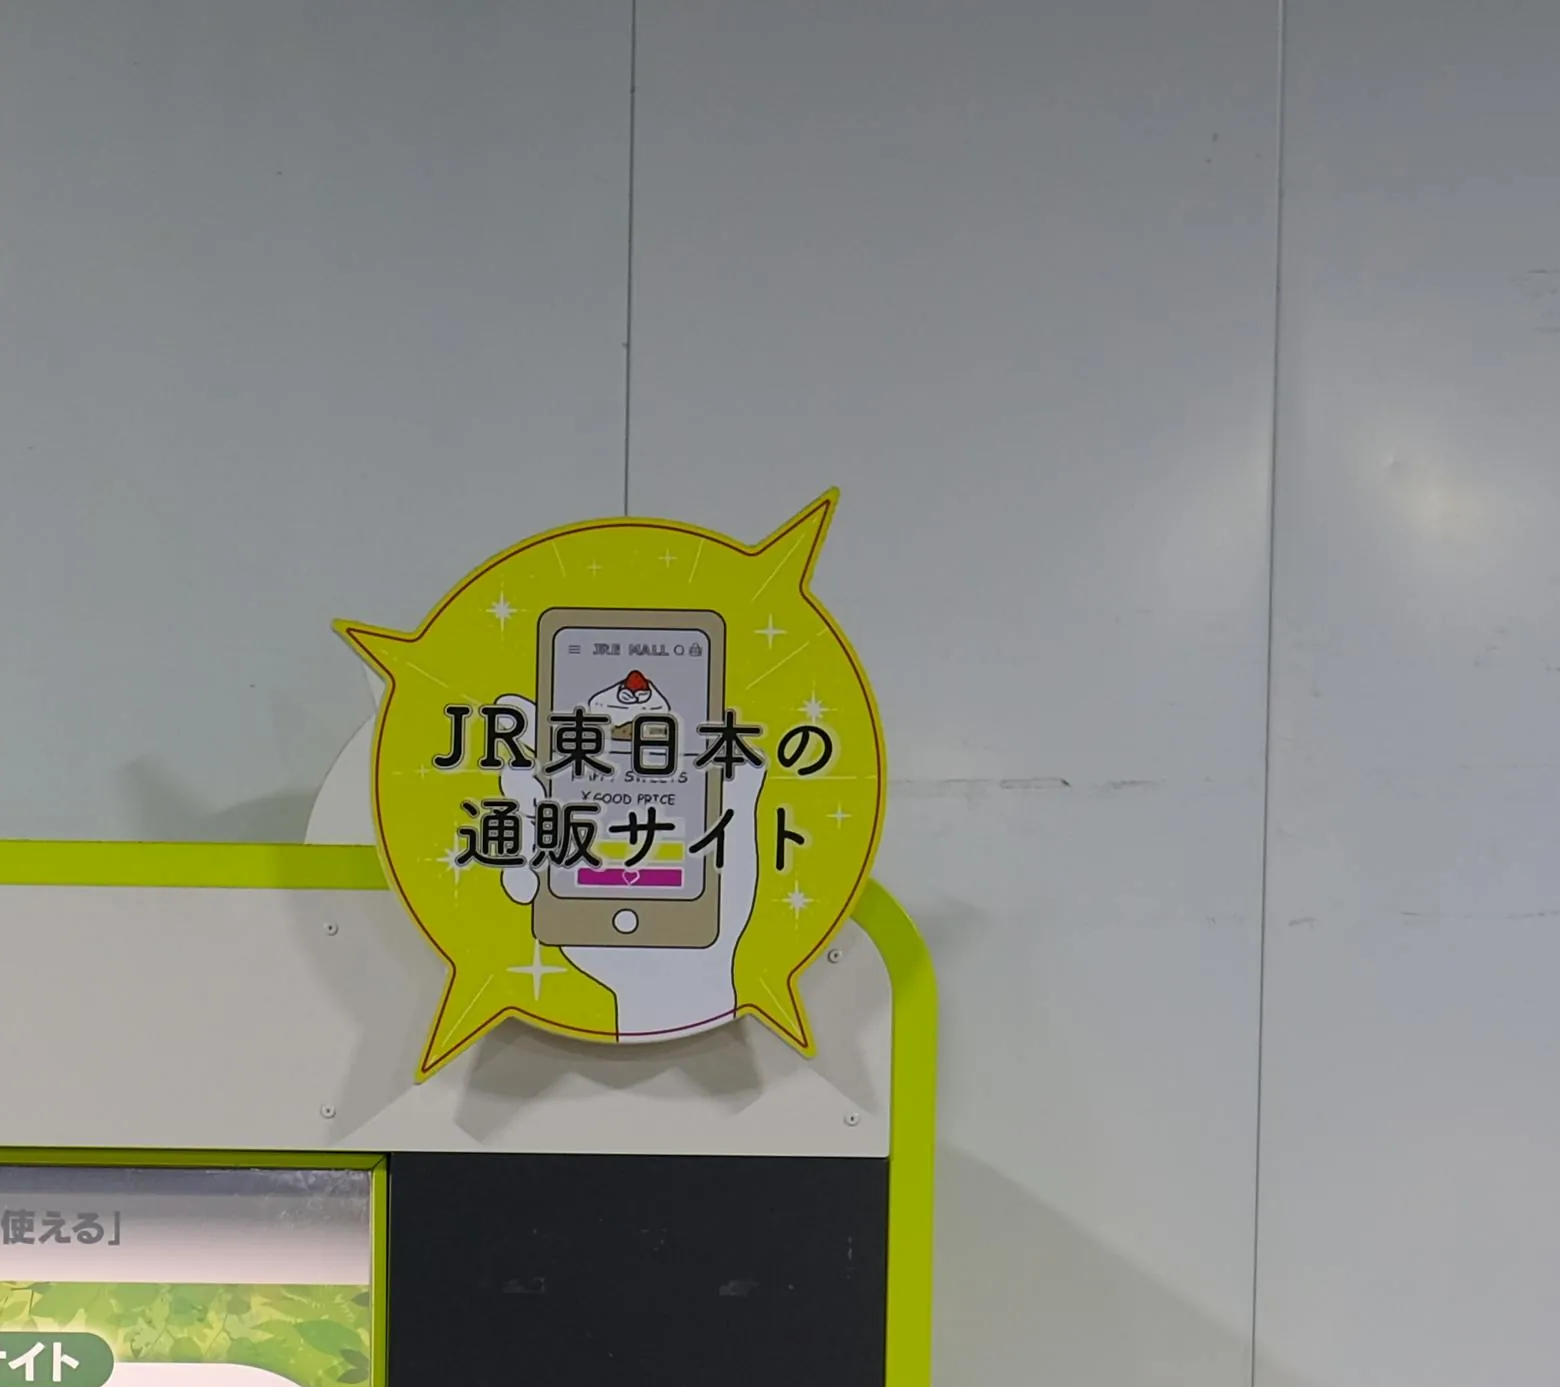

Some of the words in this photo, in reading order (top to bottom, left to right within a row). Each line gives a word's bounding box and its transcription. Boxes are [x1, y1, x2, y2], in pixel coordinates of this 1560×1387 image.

[433, 704, 833, 780] JR東日本の
[456, 803, 805, 871] 通販サイト
